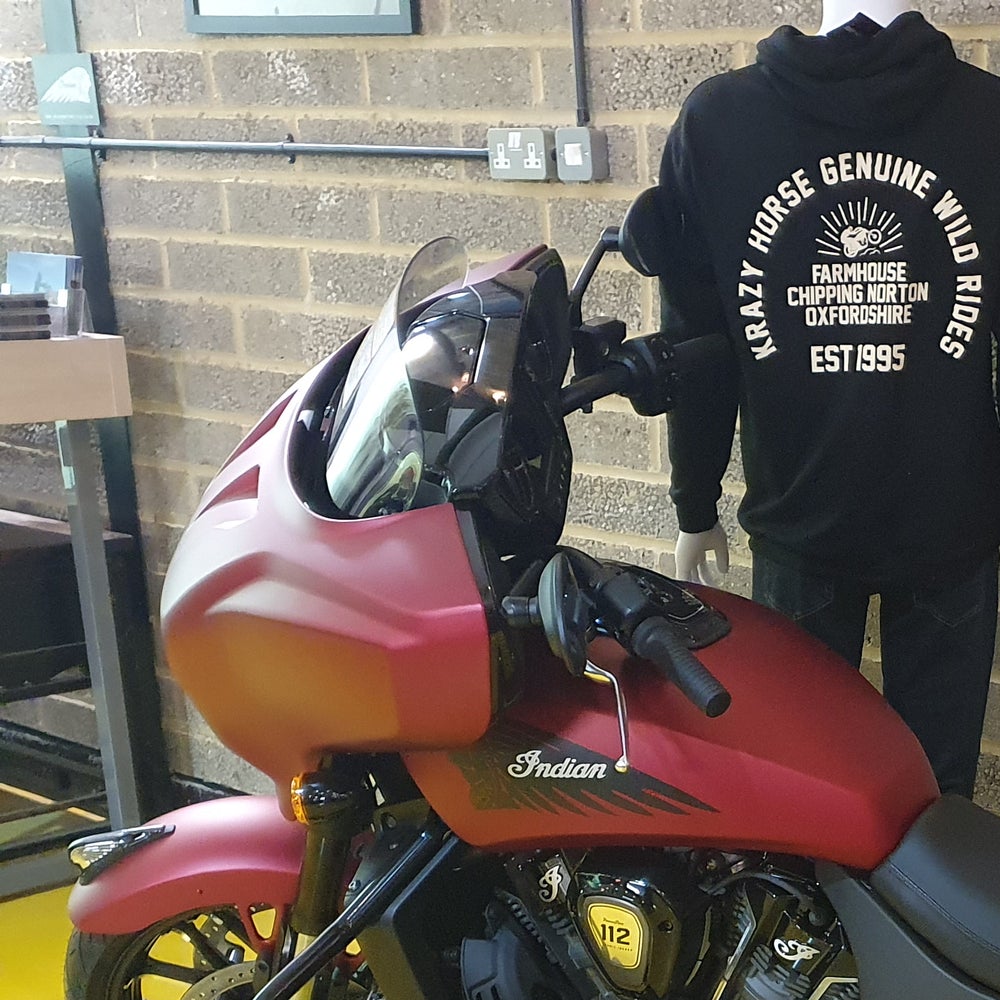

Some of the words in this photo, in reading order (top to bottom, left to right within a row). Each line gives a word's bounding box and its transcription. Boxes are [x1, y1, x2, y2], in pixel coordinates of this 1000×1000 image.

[819, 151, 938, 200] GENUINE
[747, 168, 816, 254] HORSE
[932, 189, 980, 264] WILD
[811, 261, 908, 284] FARMHOUSE
[786, 283, 864, 307] CHIPPING
[866, 281, 930, 304] NORTON
[738, 260, 778, 361] KRAZY
[804, 303, 913, 327] OXFORDSHIRE
[939, 274, 983, 360] RIDES
[810, 344, 854, 373] EST
[855, 343, 906, 373] 1995
[507, 749, 608, 779] Indian
[600, 923, 631, 946] 112
